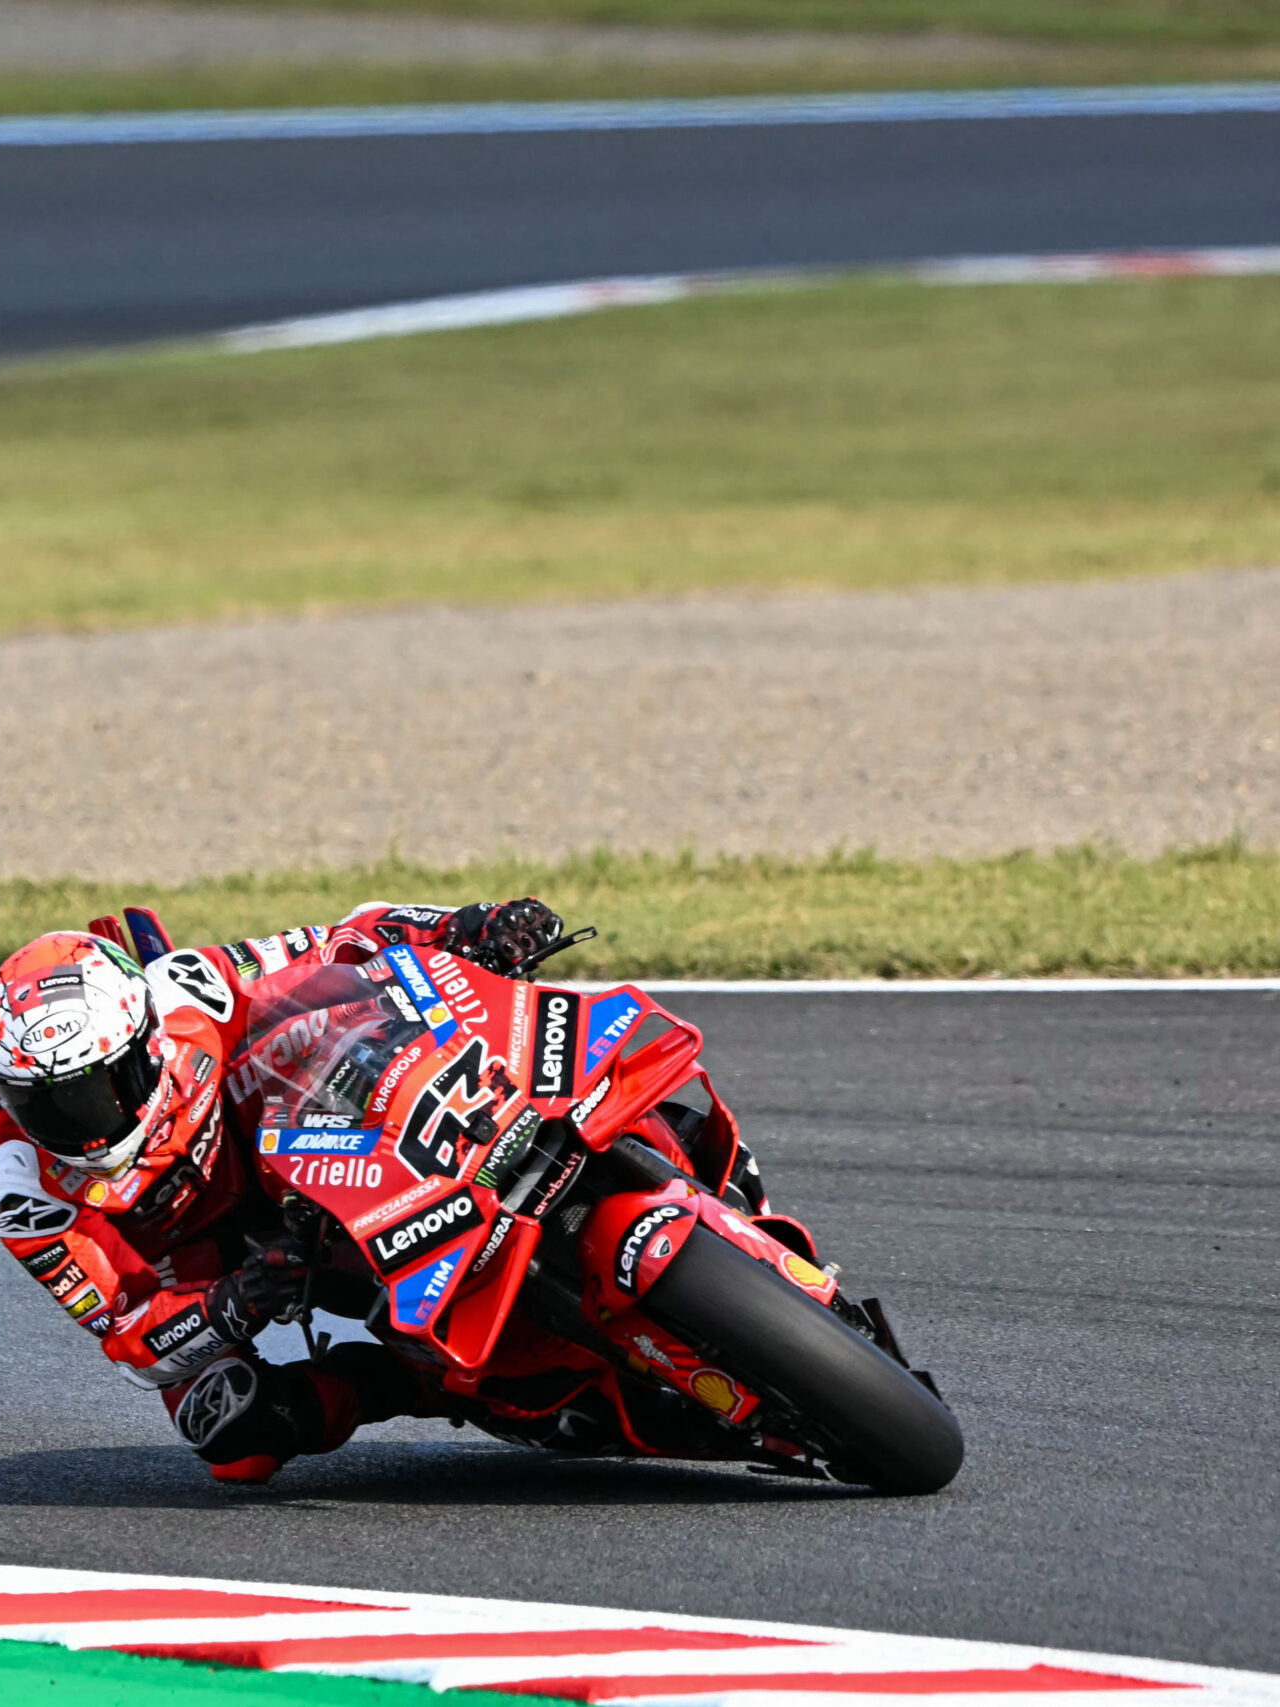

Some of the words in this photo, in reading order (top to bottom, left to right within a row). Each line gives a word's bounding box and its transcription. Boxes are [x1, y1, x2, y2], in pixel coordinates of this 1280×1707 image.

[39, 976, 80, 989] Lenovo
[428, 951, 482, 1013] riello
[24, 1019, 85, 1046] SUOMY
[604, 1006, 640, 1038] TIM
[536, 997, 569, 1093] Lenovo
[371, 1046, 422, 1113] VARGROUP
[303, 1114, 354, 1128] WRS
[486, 1109, 538, 1170] MONSTER
[288, 1134, 365, 1150] ADVANCE
[306, 1158, 382, 1188] riello
[353, 1178, 441, 1232] FRECCIAROSSA
[375, 1196, 472, 1261] Lenovo
[472, 1216, 513, 1272] CARRERA
[619, 1206, 680, 1288] Lenovo
[47, 1264, 84, 1297] ba.it
[424, 1260, 454, 1299] TIM
[150, 1313, 201, 1351] Lenovo
[169, 1331, 226, 1368] Unipol
